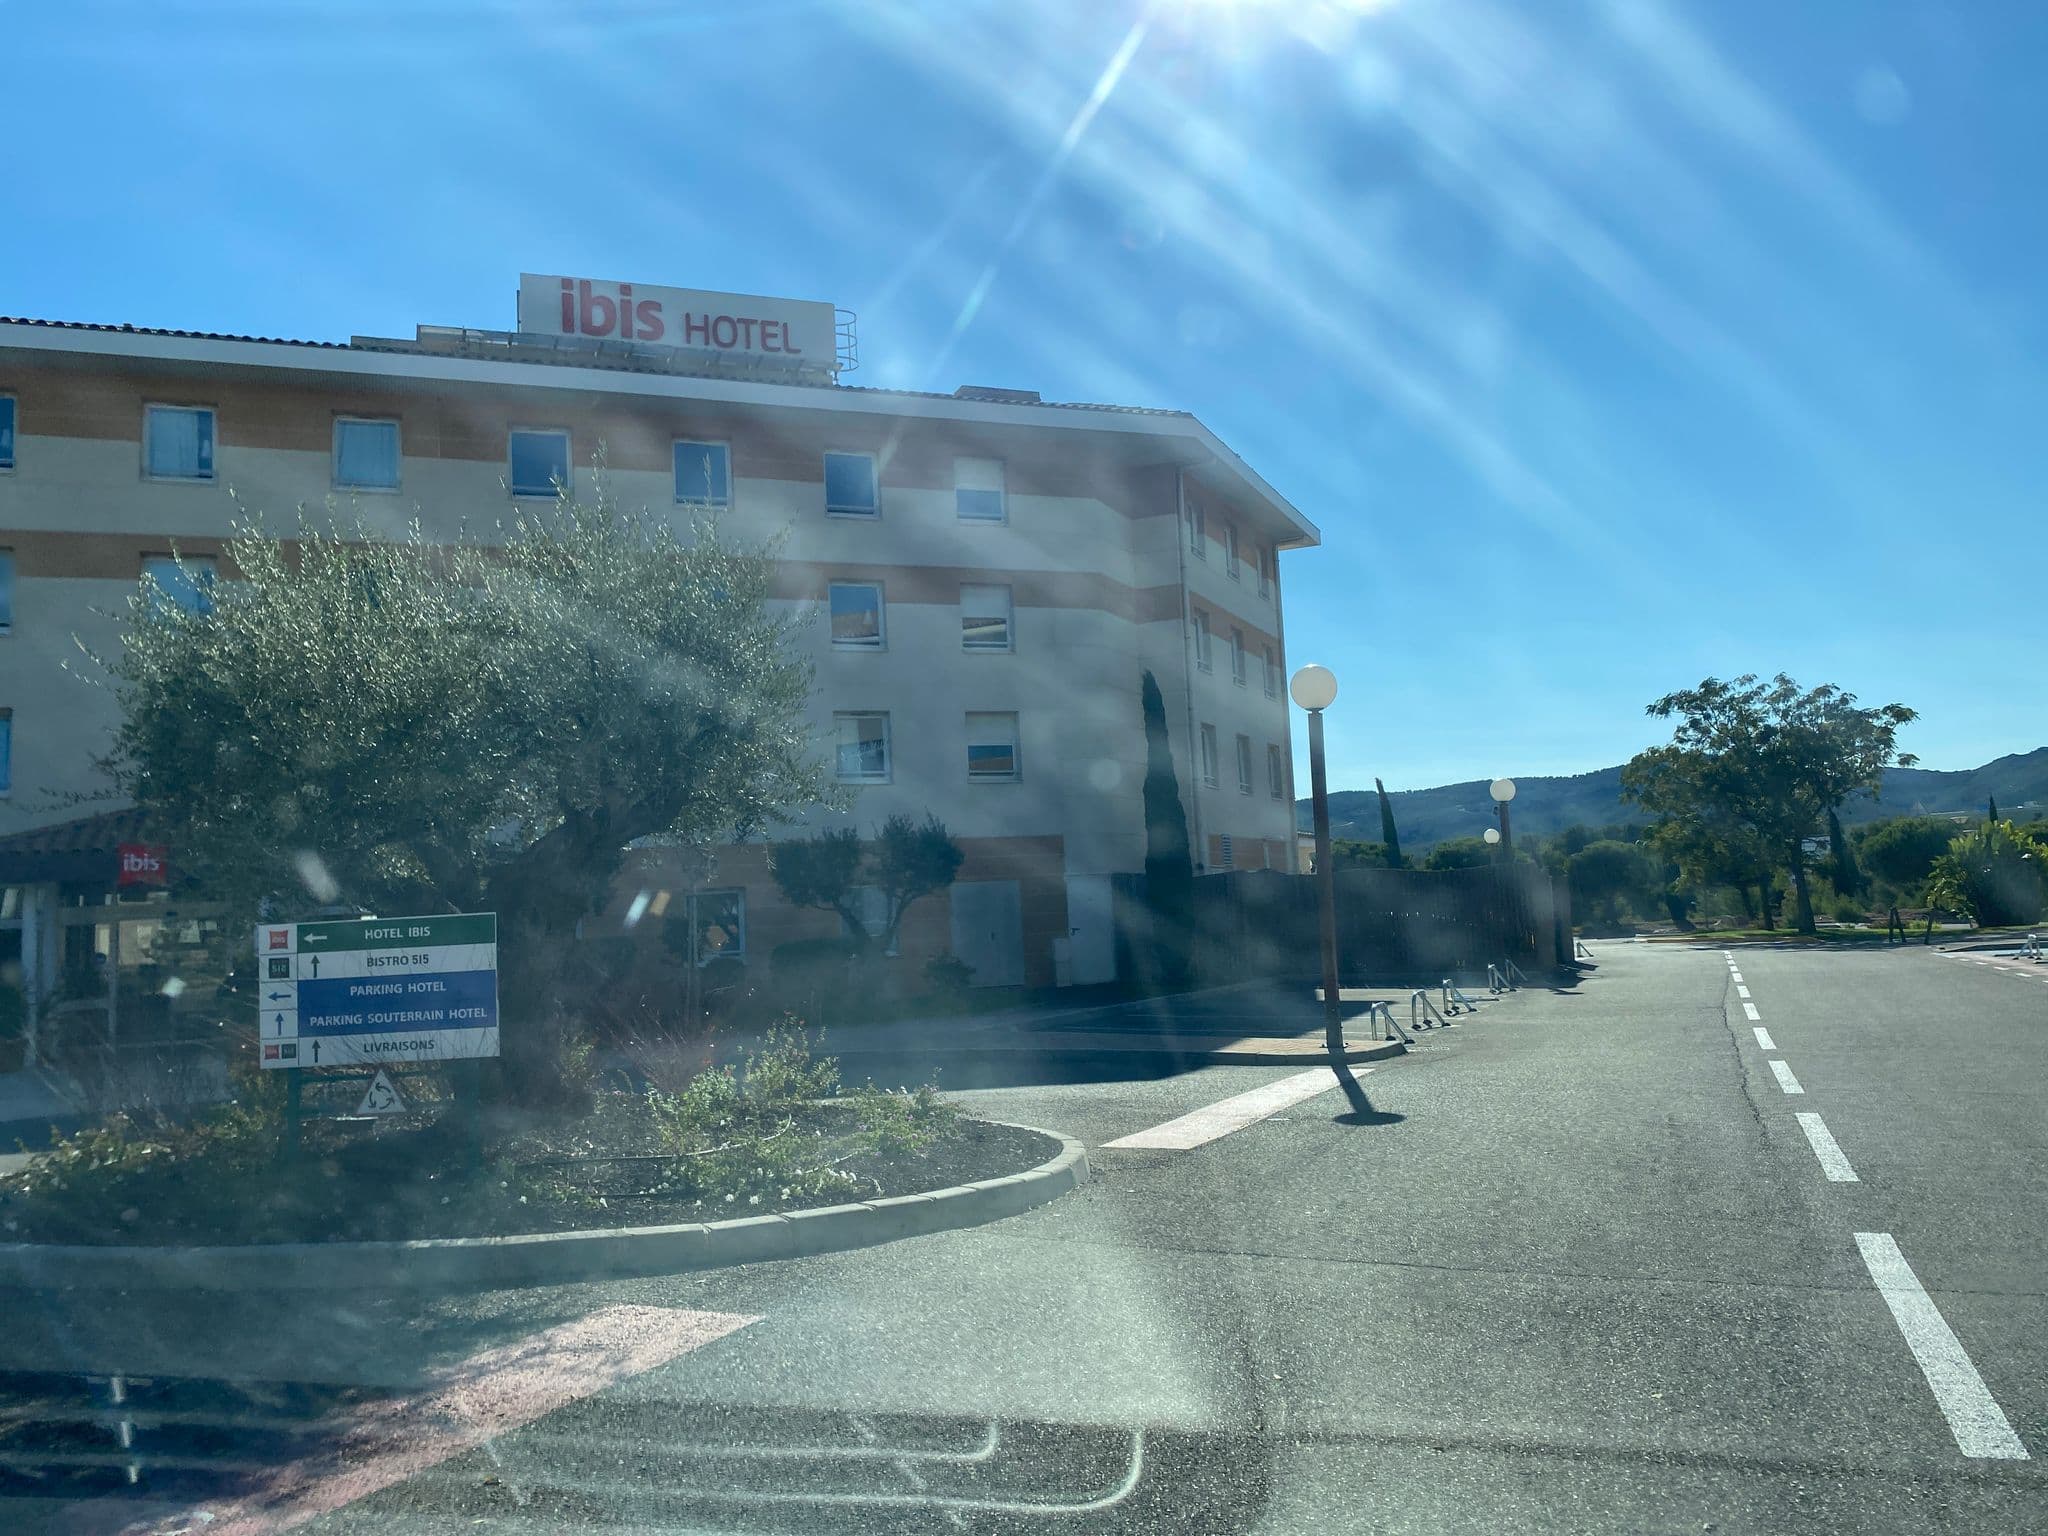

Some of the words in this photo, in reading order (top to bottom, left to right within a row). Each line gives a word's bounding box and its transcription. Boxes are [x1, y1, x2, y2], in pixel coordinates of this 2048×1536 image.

[561, 278, 665, 342] ibis
[683, 311, 801, 354] HOTEL
[123, 853, 160, 872] ibis
[365, 928, 403, 940] HOTEL
[408, 926, 430, 937] IBIS
[367, 955, 409, 967] BISTRO
[350, 984, 403, 996] PARKING
[408, 982, 447, 993] HOTEL
[310, 1015, 362, 1027] PARKING
[368, 1010, 444, 1024] SOUTERRAIN
[449, 1008, 488, 1019] HOTEL
[364, 1040, 435, 1053] LIVRAISONS
